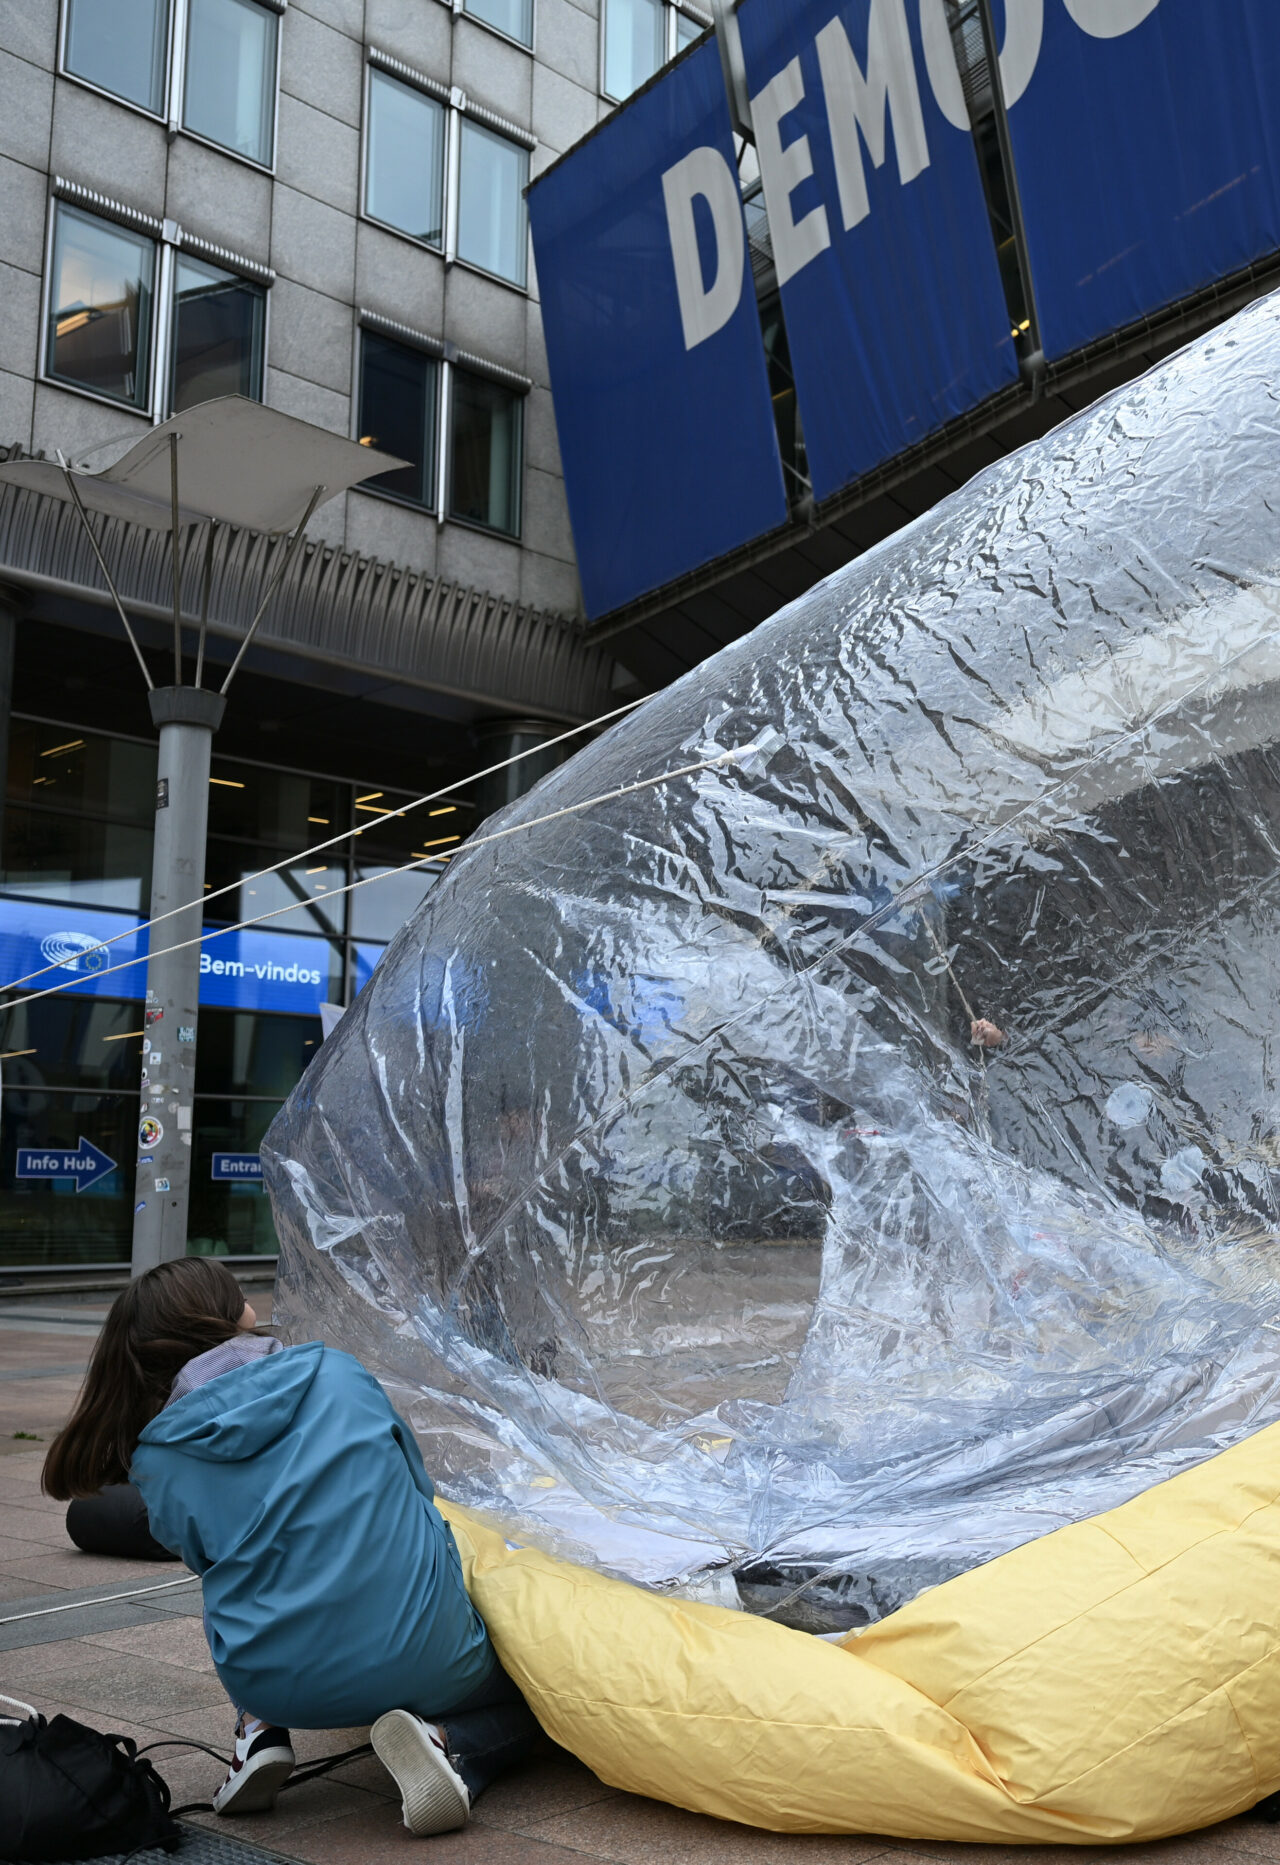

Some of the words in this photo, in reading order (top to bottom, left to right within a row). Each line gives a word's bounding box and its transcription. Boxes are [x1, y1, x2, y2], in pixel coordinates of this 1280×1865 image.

[662, 0, 1160, 351] DEMO
[199, 953, 321, 985] Bem-vindos
[26, 1155, 59, 1170] Info
[64, 1156, 96, 1170] Hub
